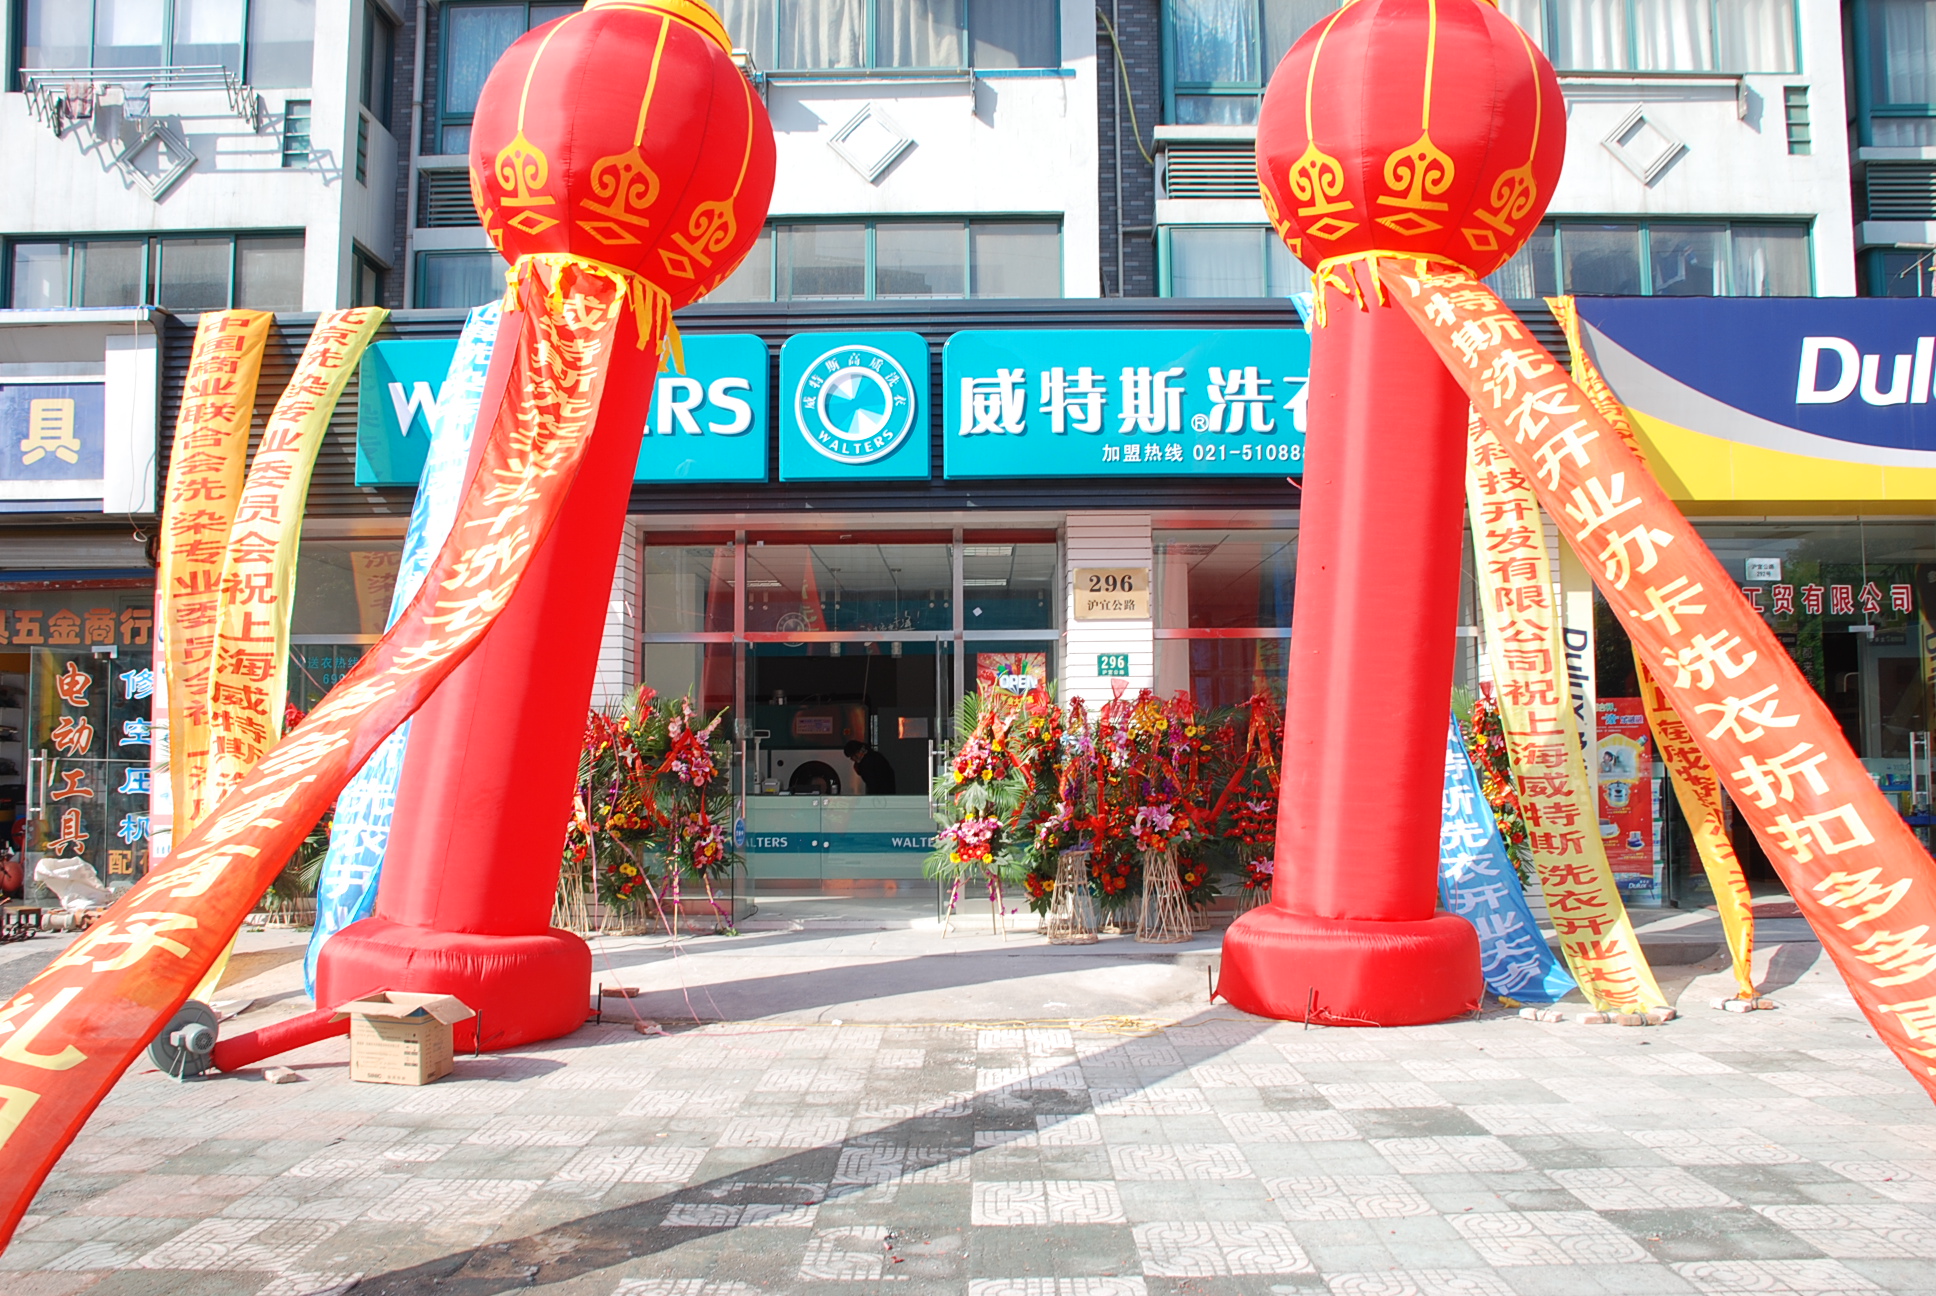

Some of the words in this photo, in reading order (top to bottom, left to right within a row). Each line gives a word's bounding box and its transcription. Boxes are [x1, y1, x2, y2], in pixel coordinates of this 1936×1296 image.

[1796, 336, 1936, 407] Dul
[20, 398, 81, 466] 具
[818, 429, 894, 454] WALTERS
[1102, 443, 1184, 463] 加盟热线
[1192, 444, 1308, 463] 021-51088
[1088, 574, 1134, 593] 296
[1087, 599, 1136, 611] 沪宜公路
[1742, 581, 1913, 615] 工贸有限公司
[0, 607, 152, 646] 五金商行
[1100, 655, 1125, 669] 296
[999, 674, 1038, 690] OPEN
[48, 660, 95, 856] 电动工具
